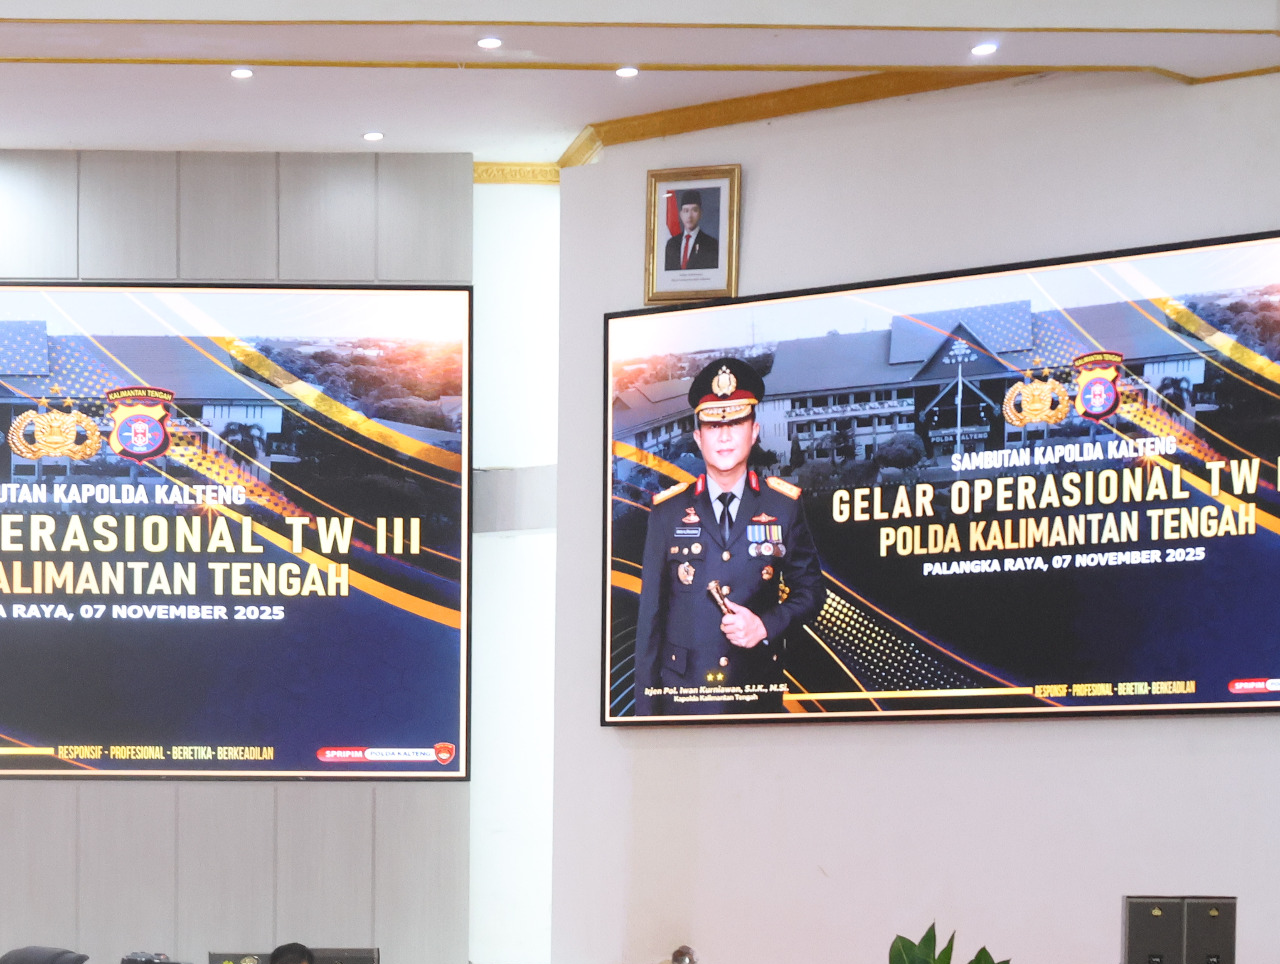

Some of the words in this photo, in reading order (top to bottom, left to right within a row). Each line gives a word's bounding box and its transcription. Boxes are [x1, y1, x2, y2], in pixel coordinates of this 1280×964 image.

[108, 389, 147, 400] KALIMANTAN
[147, 389, 172, 401] TENGAH
[956, 432, 988, 441] ALTENG
[951, 448, 1030, 472] SAMBUTAN
[1034, 442, 1104, 465] KAPOLDA
[1107, 435, 1177, 459] KALTENG
[54, 483, 148, 504] KAPOLDA
[155, 484, 246, 505] KALTENG
[832, 483, 934, 523] GELAR
[950, 464, 1190, 515] OPERASIONAL
[1205, 457, 1261, 497] TW
[285, 516, 354, 554] TW
[376, 517, 420, 555] III
[880, 522, 961, 557] POLDA
[970, 510, 1139, 552] KALIMANTAN
[1146, 502, 1257, 540] TENGAH
[923, 559, 1001, 576] PALANGKA
[1003, 556, 1048, 572] RAYA,
[1052, 554, 1071, 569] 07
[1075, 550, 1162, 568] NOVEMBER
[1165, 546, 1206, 562] 2025
[207, 562, 349, 597] TENGAH
[12, 604, 74, 621] RAYA,
[80, 604, 106, 619] 07
[112, 604, 229, 620] NOVEMBER
[233, 605, 285, 620] 2025
[58, 746, 103, 759] RESPONSIF
[110, 746, 165, 760] PROFESIONAL
[217, 746, 274, 760] BERKEADILAN
[325, 750, 363, 758] SPRIPIM
